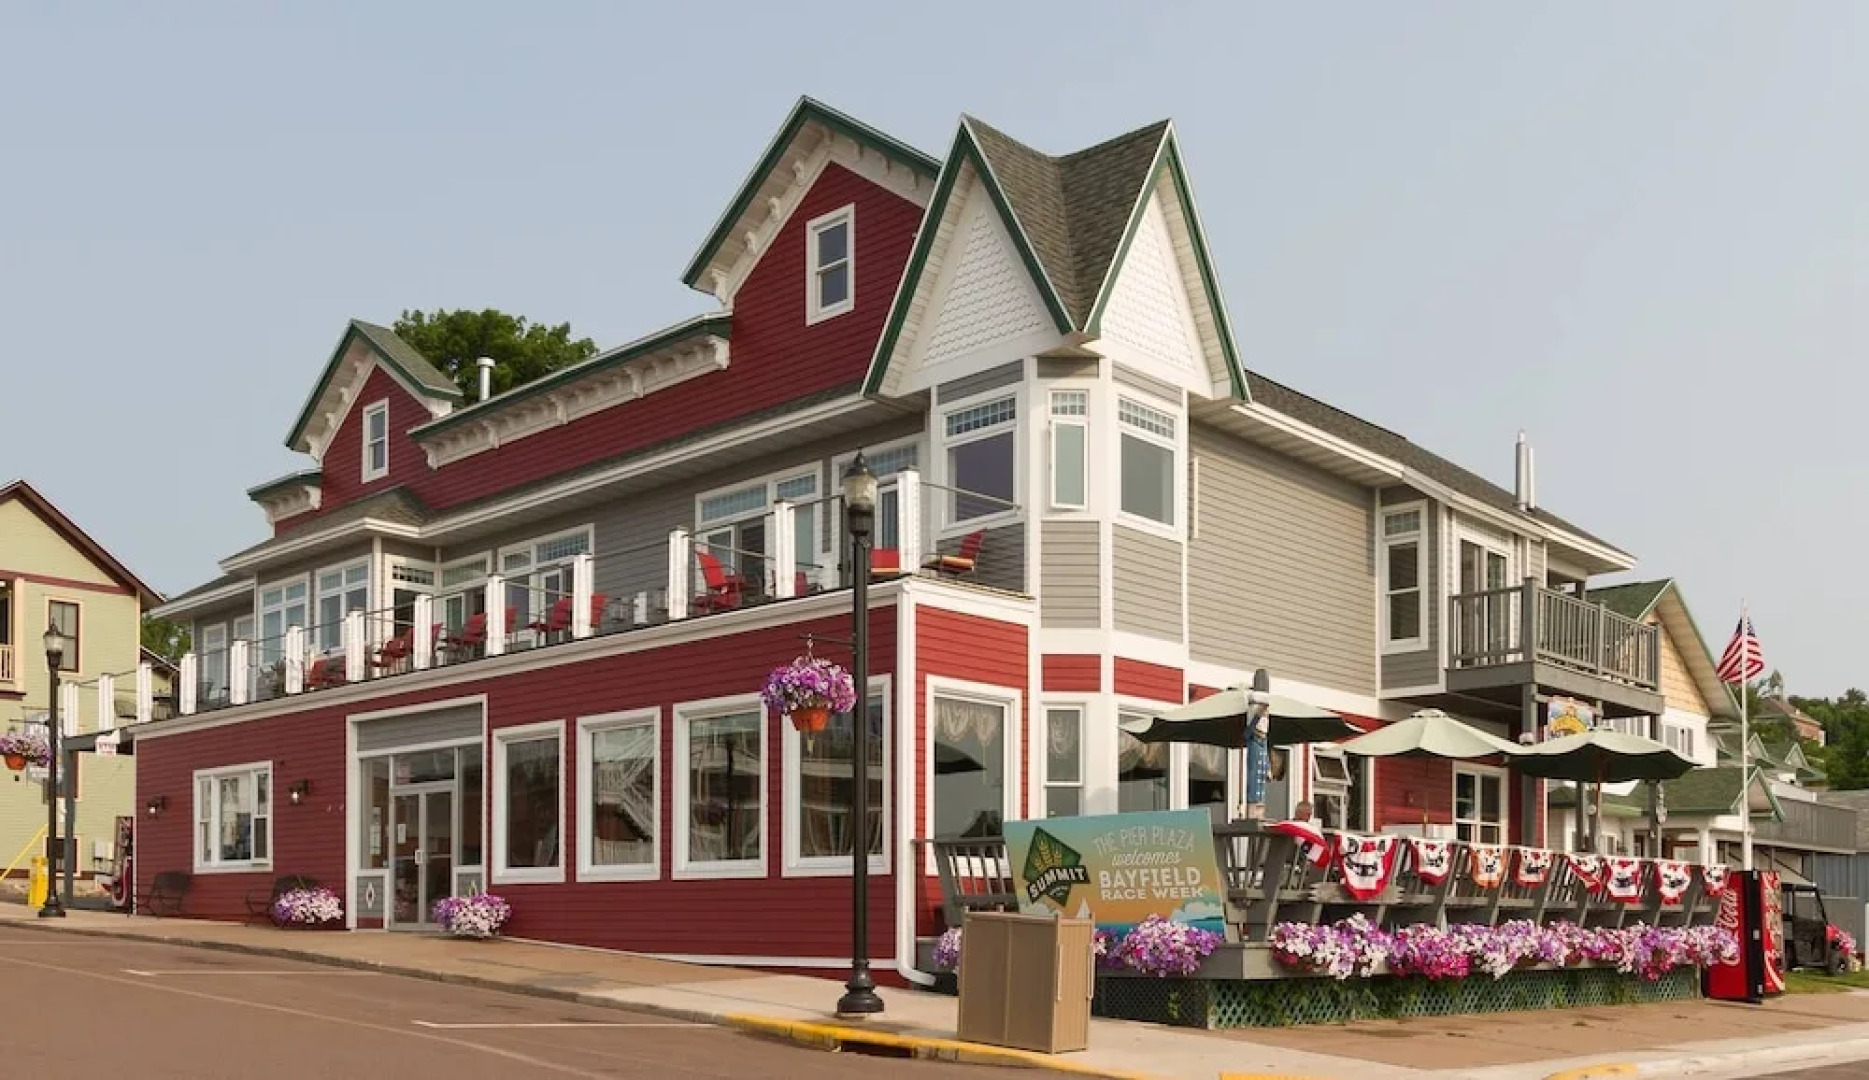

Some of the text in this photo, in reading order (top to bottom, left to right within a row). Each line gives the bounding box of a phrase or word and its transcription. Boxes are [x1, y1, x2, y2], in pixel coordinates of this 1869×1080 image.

[1092, 826, 1196, 857] THE PIER PLAZA
[1111, 850, 1182, 867] welcomes
[1029, 868, 1085, 898] SUMMIT
[1099, 867, 1201, 889] BAYFIELD
[1101, 886, 1204, 900] RACE WEEK
